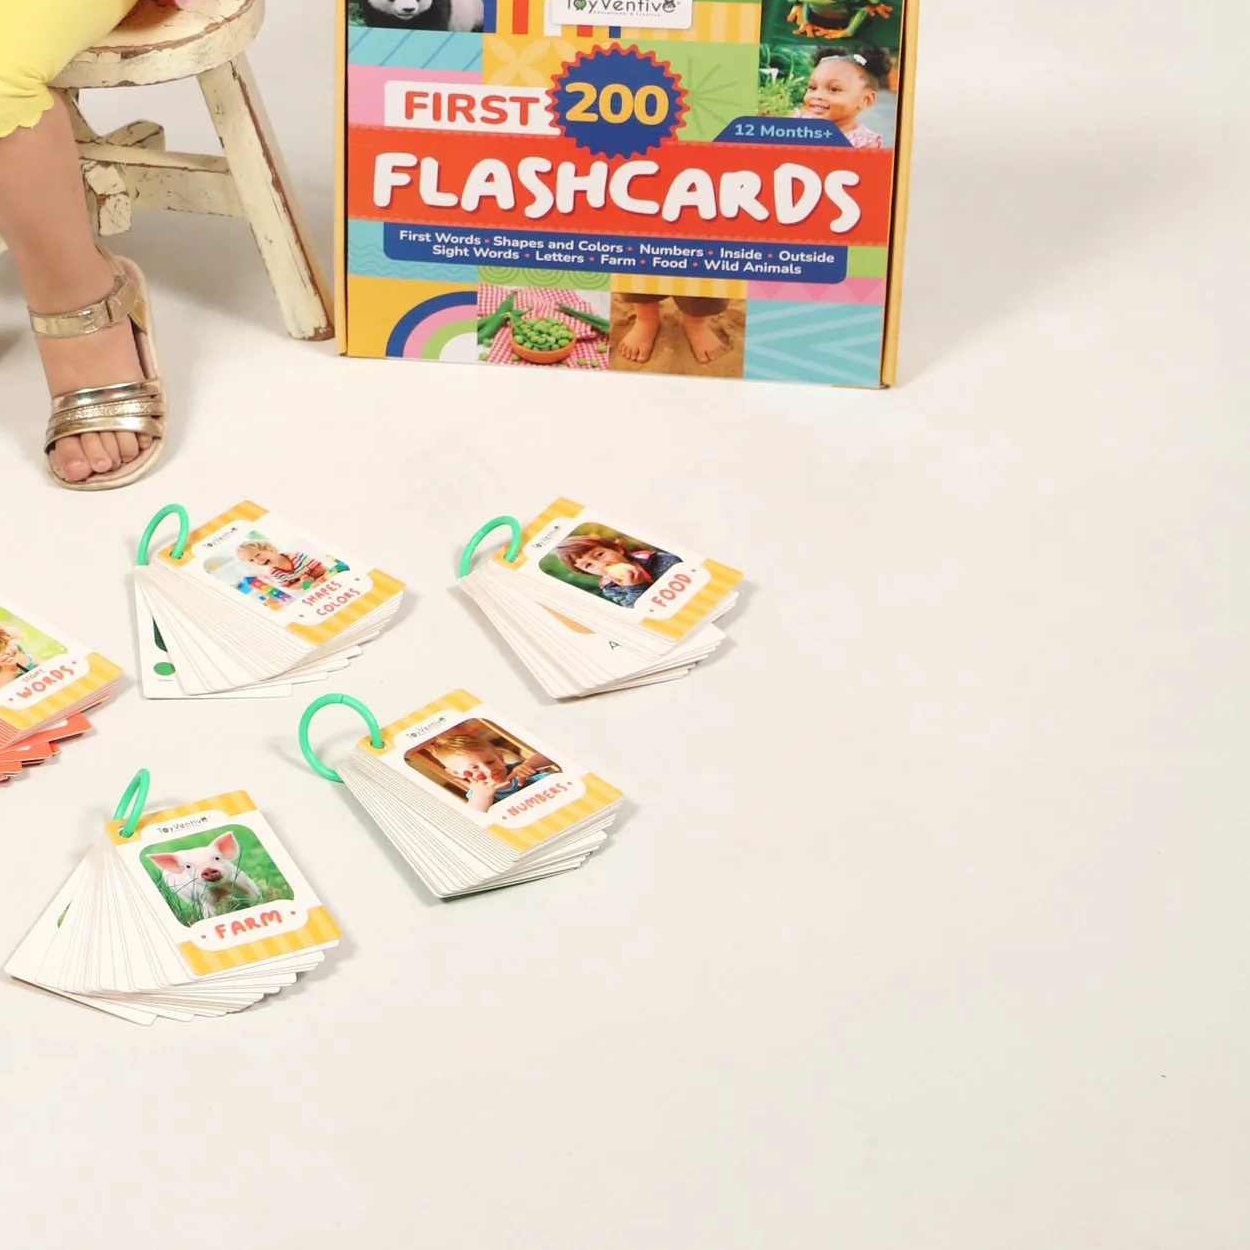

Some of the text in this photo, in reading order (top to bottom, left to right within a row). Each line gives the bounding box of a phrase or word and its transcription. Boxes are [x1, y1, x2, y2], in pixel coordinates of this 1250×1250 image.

[403, 90, 540, 127] FIRST
[565, 81, 669, 126] 200
[734, 122, 833, 140] 12 Months+
[372, 151, 861, 234] FLASHCARDS
[400, 230, 835, 263] First Words Shapes and Colors Numbers Inside Outside
[432, 244, 802, 275] Sight Words Letters Farm Food Wild Animals
[301, 580, 342, 607] SHAPES
[316, 587, 361, 616] COLORS
[650, 573, 692, 608] FOOD
[16, 665, 75, 699] WORDS
[506, 782, 568, 817] NUMBERS
[213, 909, 284, 940] FARM
